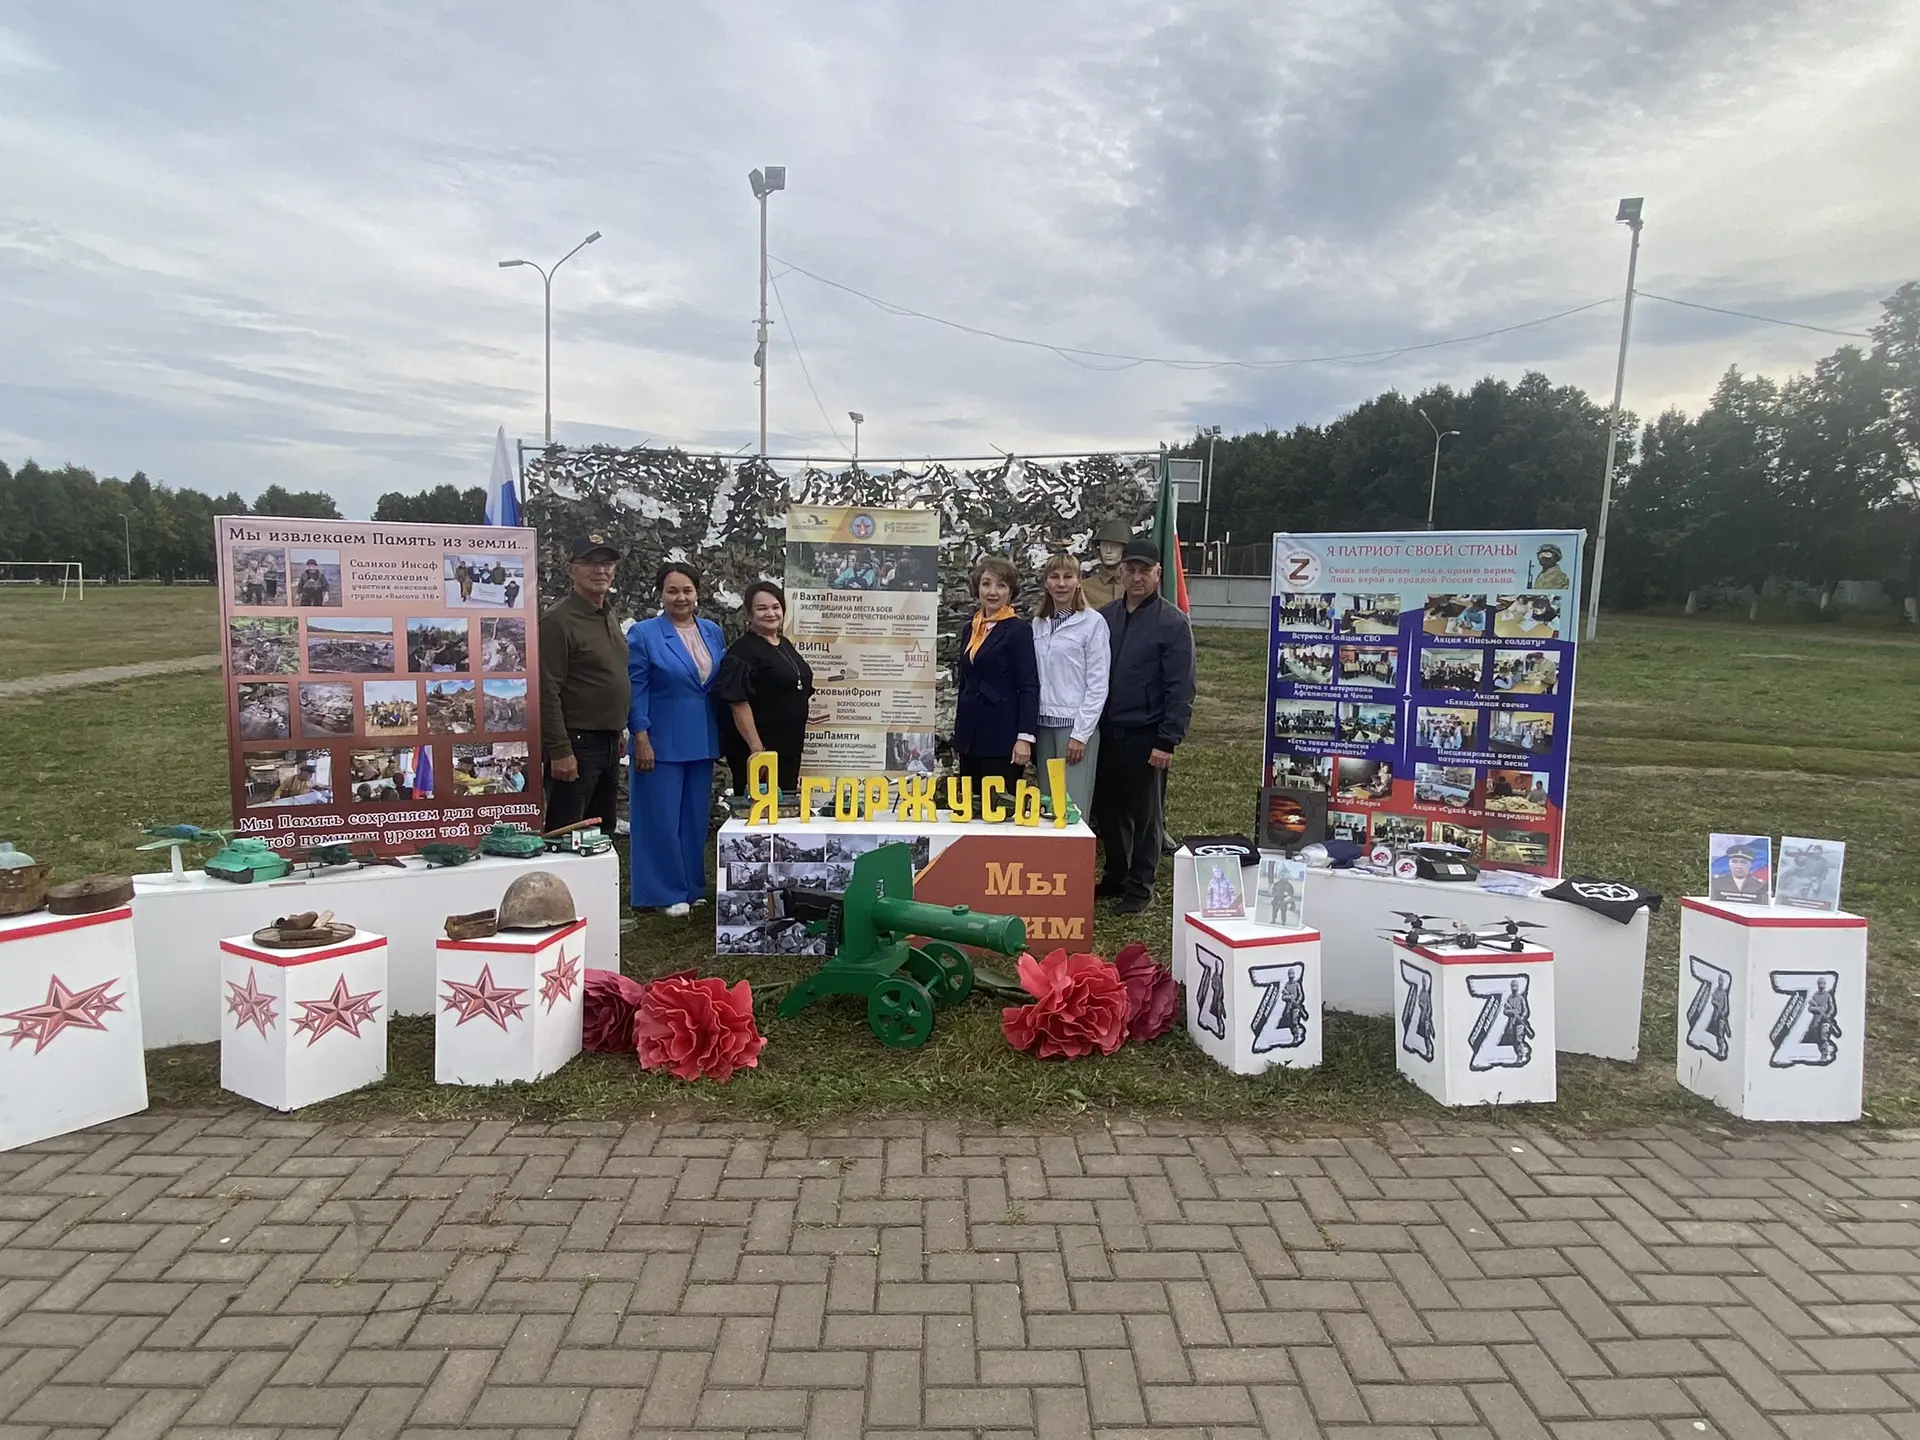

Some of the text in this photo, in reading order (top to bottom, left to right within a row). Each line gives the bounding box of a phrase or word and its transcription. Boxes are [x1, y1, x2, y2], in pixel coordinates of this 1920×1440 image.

[229, 528, 528, 550] Мы извлекаем Память из земли...
[1326, 546, 1335, 556] Я
[1339, 545, 1402, 557] ПАТРИОТ
[1405, 543, 1453, 556] СВОЕЙ
[1458, 544, 1518, 556] СТРАНЫ
[350, 559, 438, 571] Салихов Инсаф
[1289, 558, 1310, 580] Z
[352, 572, 429, 581] Габделхаевич
[1373, 567, 1410, 576] бросаем
[1447, 568, 1481, 576] армию
[1359, 576, 1385, 584] верой
[1398, 576, 1437, 585] правдой
[800, 604, 843, 612] ЭКСПЕДИЦИИ
[821, 612, 851, 620] ВЕЛИКОЙ
[852, 613, 905, 621] ОТЕЧЕСТВЕННОЙ
[1292, 633, 1322, 641] Встреча
[1363, 634, 1381, 642] СВО
[1433, 635, 1461, 644] Акция
[1294, 682, 1322, 690] Встреча
[813, 688, 882, 698] сковыйФронт
[1474, 692, 1500, 700] Акция
[804, 731, 860, 741] аршПамяти
[746, 751, 779, 826] Я
[240, 803, 540, 832] Мы Память сохраняем для страны,
[384, 829, 436, 845] уроки
[439, 824, 469, 838] той
[474, 820, 532, 836] воы.
[985, 862, 1067, 896] Мы
[1020, 917, 1085, 939] им
